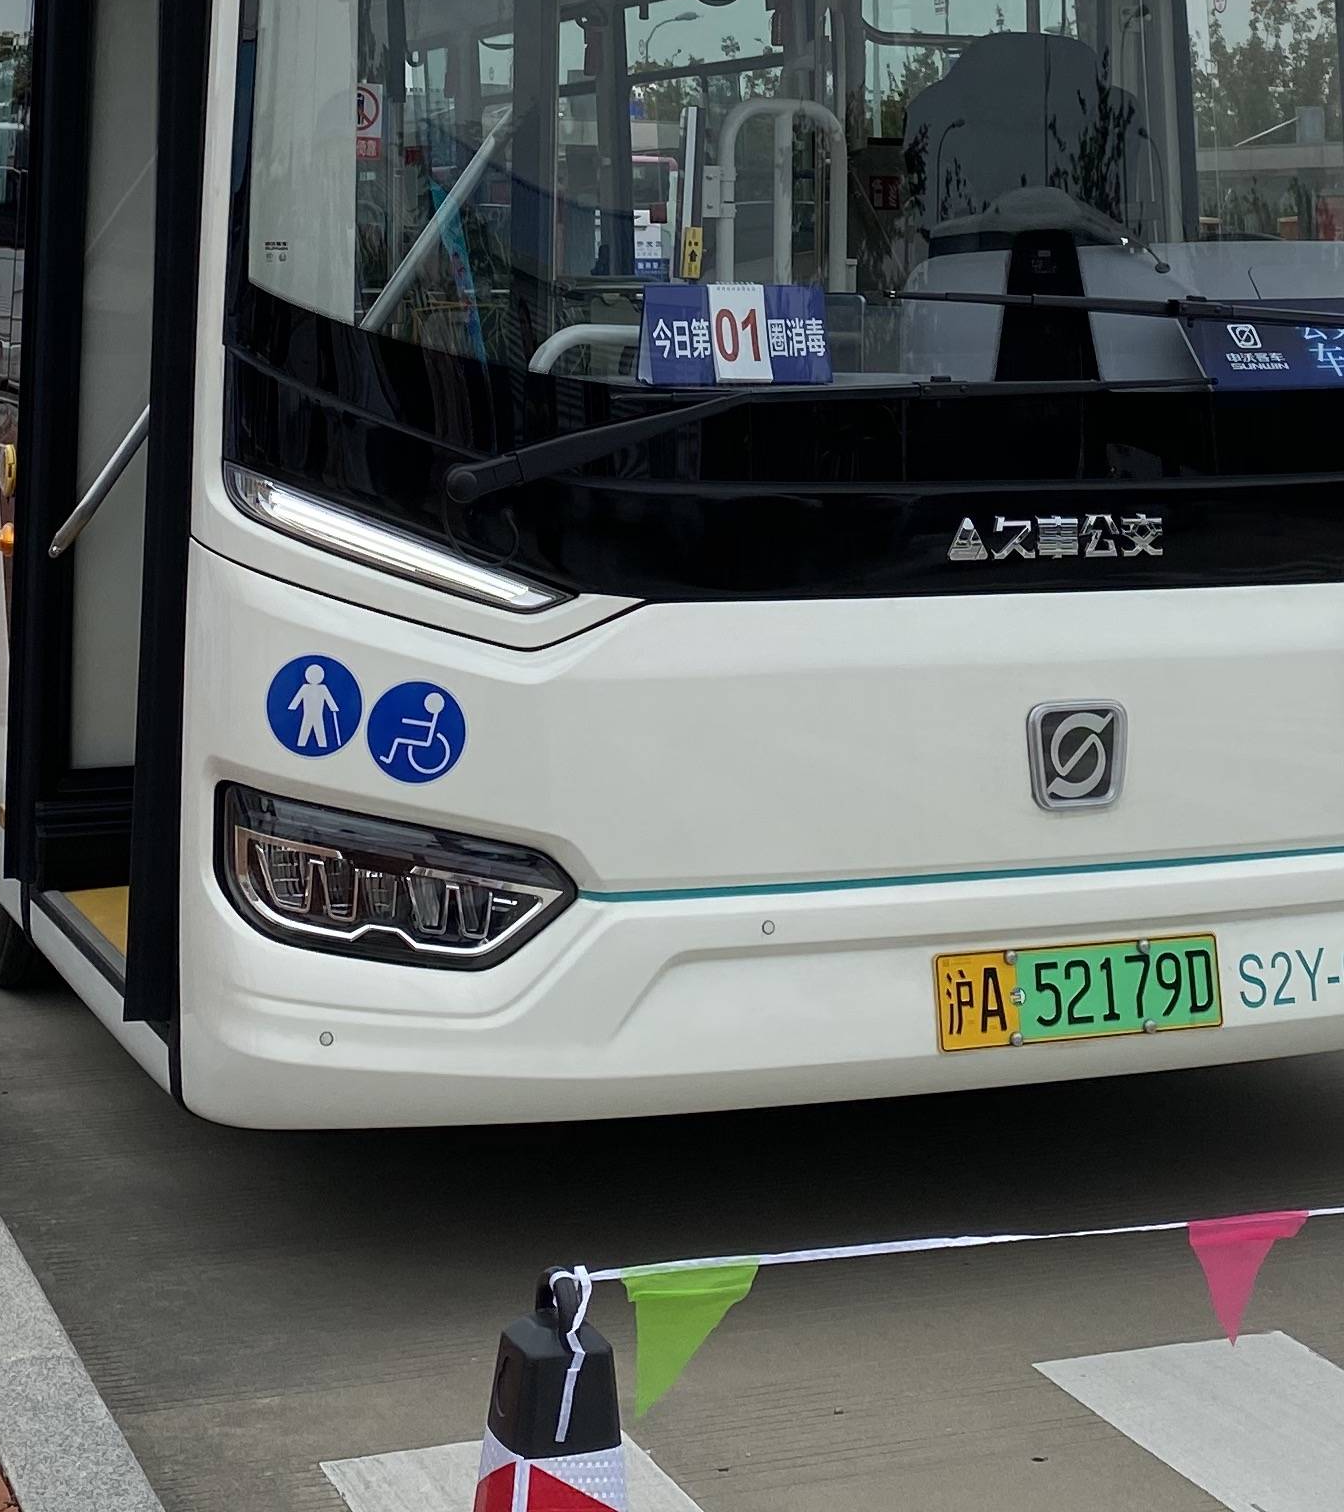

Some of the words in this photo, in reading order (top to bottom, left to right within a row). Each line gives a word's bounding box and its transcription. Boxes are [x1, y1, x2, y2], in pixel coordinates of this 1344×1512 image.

[652, 318, 712, 359] 今日第
[715, 308, 762, 363] 01
[767, 317, 827, 358] 圈消毒
[990, 513, 1164, 561] 久事公交
